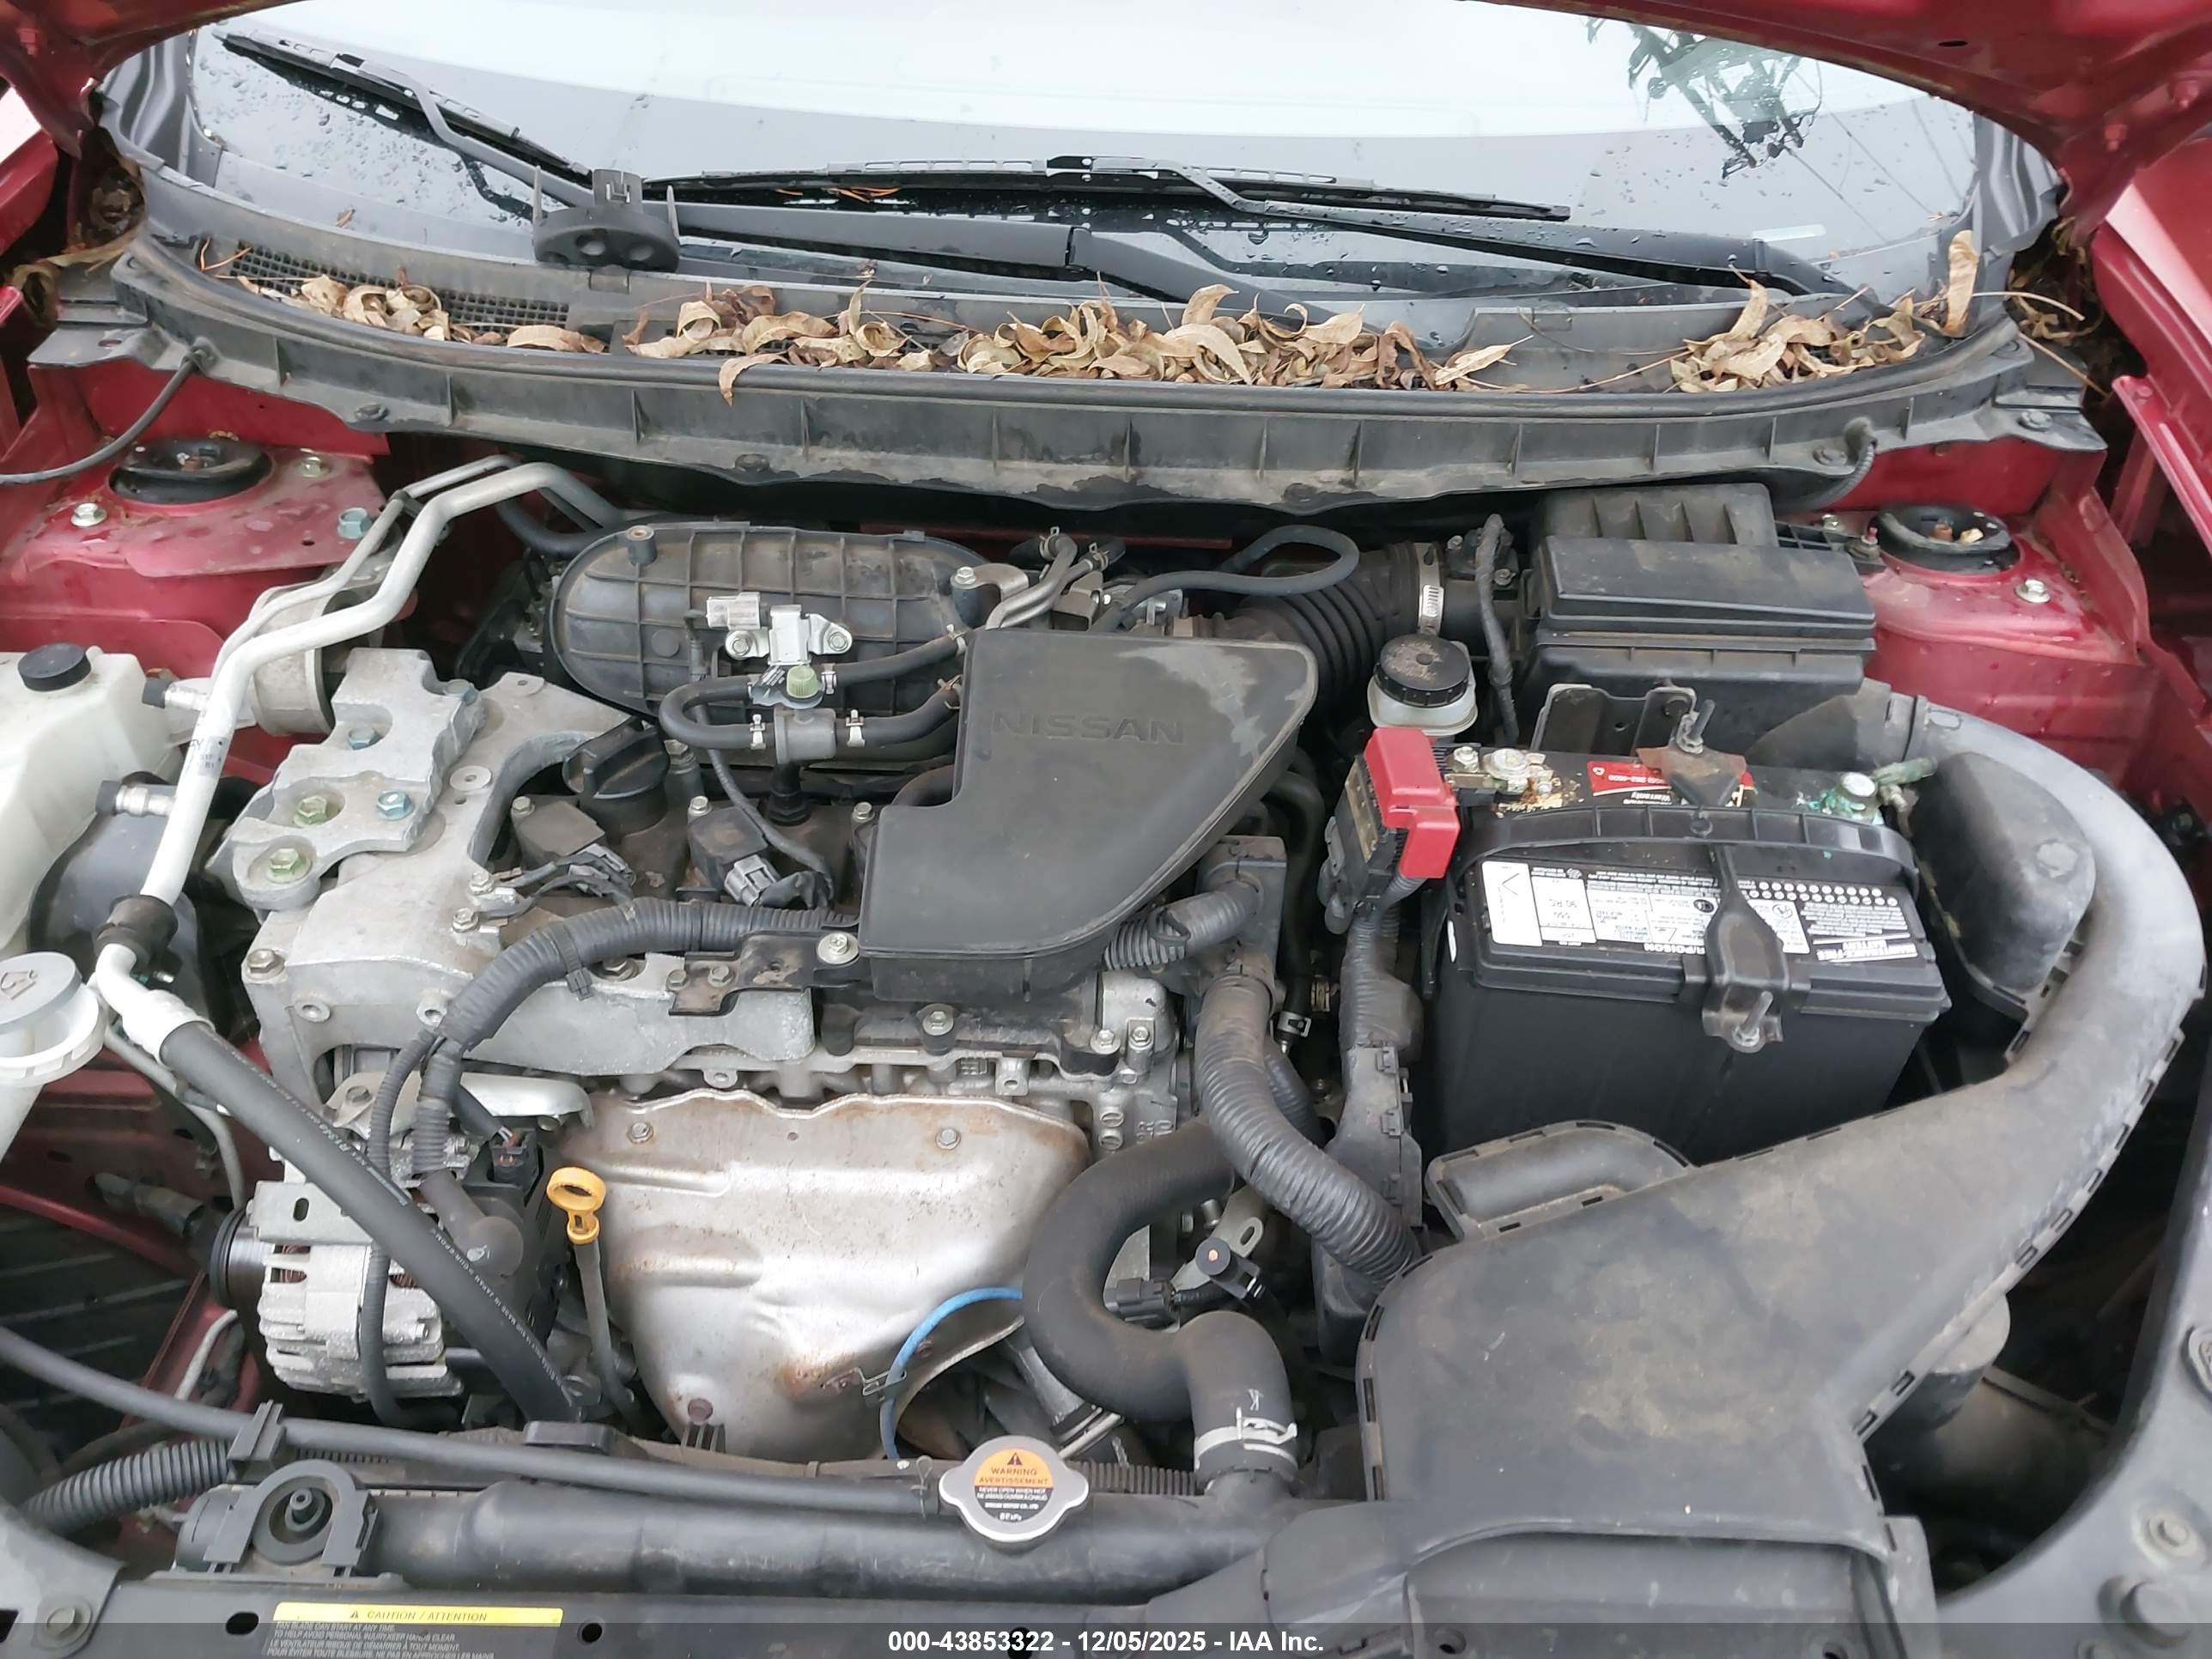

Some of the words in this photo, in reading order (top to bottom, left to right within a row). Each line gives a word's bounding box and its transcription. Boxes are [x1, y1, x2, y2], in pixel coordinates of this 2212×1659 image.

[991, 712, 1184, 745] NISSAN
[991, 1468, 1038, 1476] WARNING
[368, 1611, 416, 1620] CAUTION
[427, 1612, 488, 1621] ATTENTION
[290, 1622, 314, 1631] BLADE
[314, 1623, 330, 1632] CAN
[331, 1623, 352, 1632] START
[362, 1624, 379, 1632] ANY
[275, 1630, 283, 1638] TO
[284, 1631, 302, 1639] HELP
[303, 1631, 325, 1639] AVOID
[325, 1632, 362, 1640] PERSONAL
[432, 1633, 455, 1642] CLEAR
[270, 1639, 280, 1648] LE
[280, 1640, 325, 1649] VENTILATEUR
[352, 1641, 362, 1650] DE
[410, 1643, 428, 1651] TOUT
[266, 1648, 288, 1657] POUR
